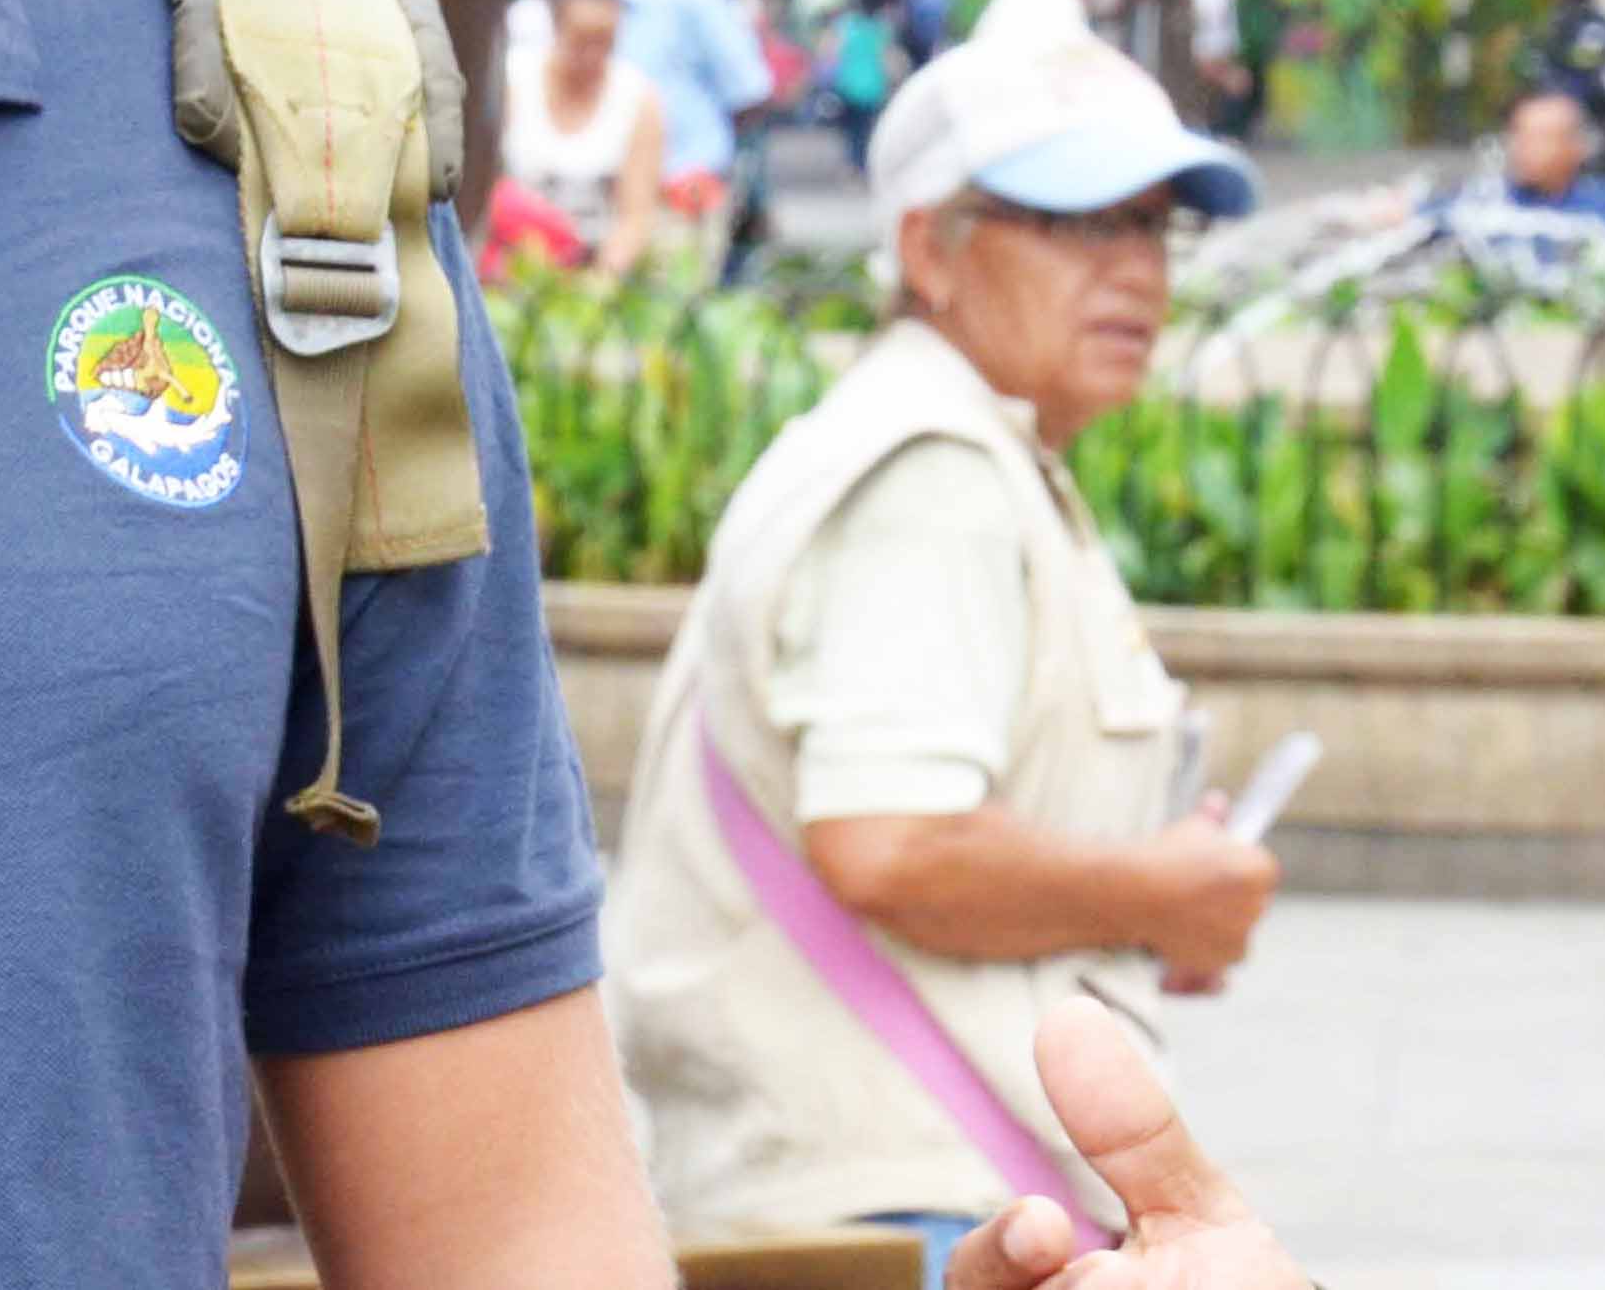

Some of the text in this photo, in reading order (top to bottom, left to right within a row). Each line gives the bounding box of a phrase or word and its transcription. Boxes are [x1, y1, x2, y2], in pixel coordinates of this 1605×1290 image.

[54, 283, 241, 407] PARQUE NACIONAL
[90, 438, 241, 501] GALAPAGOS
